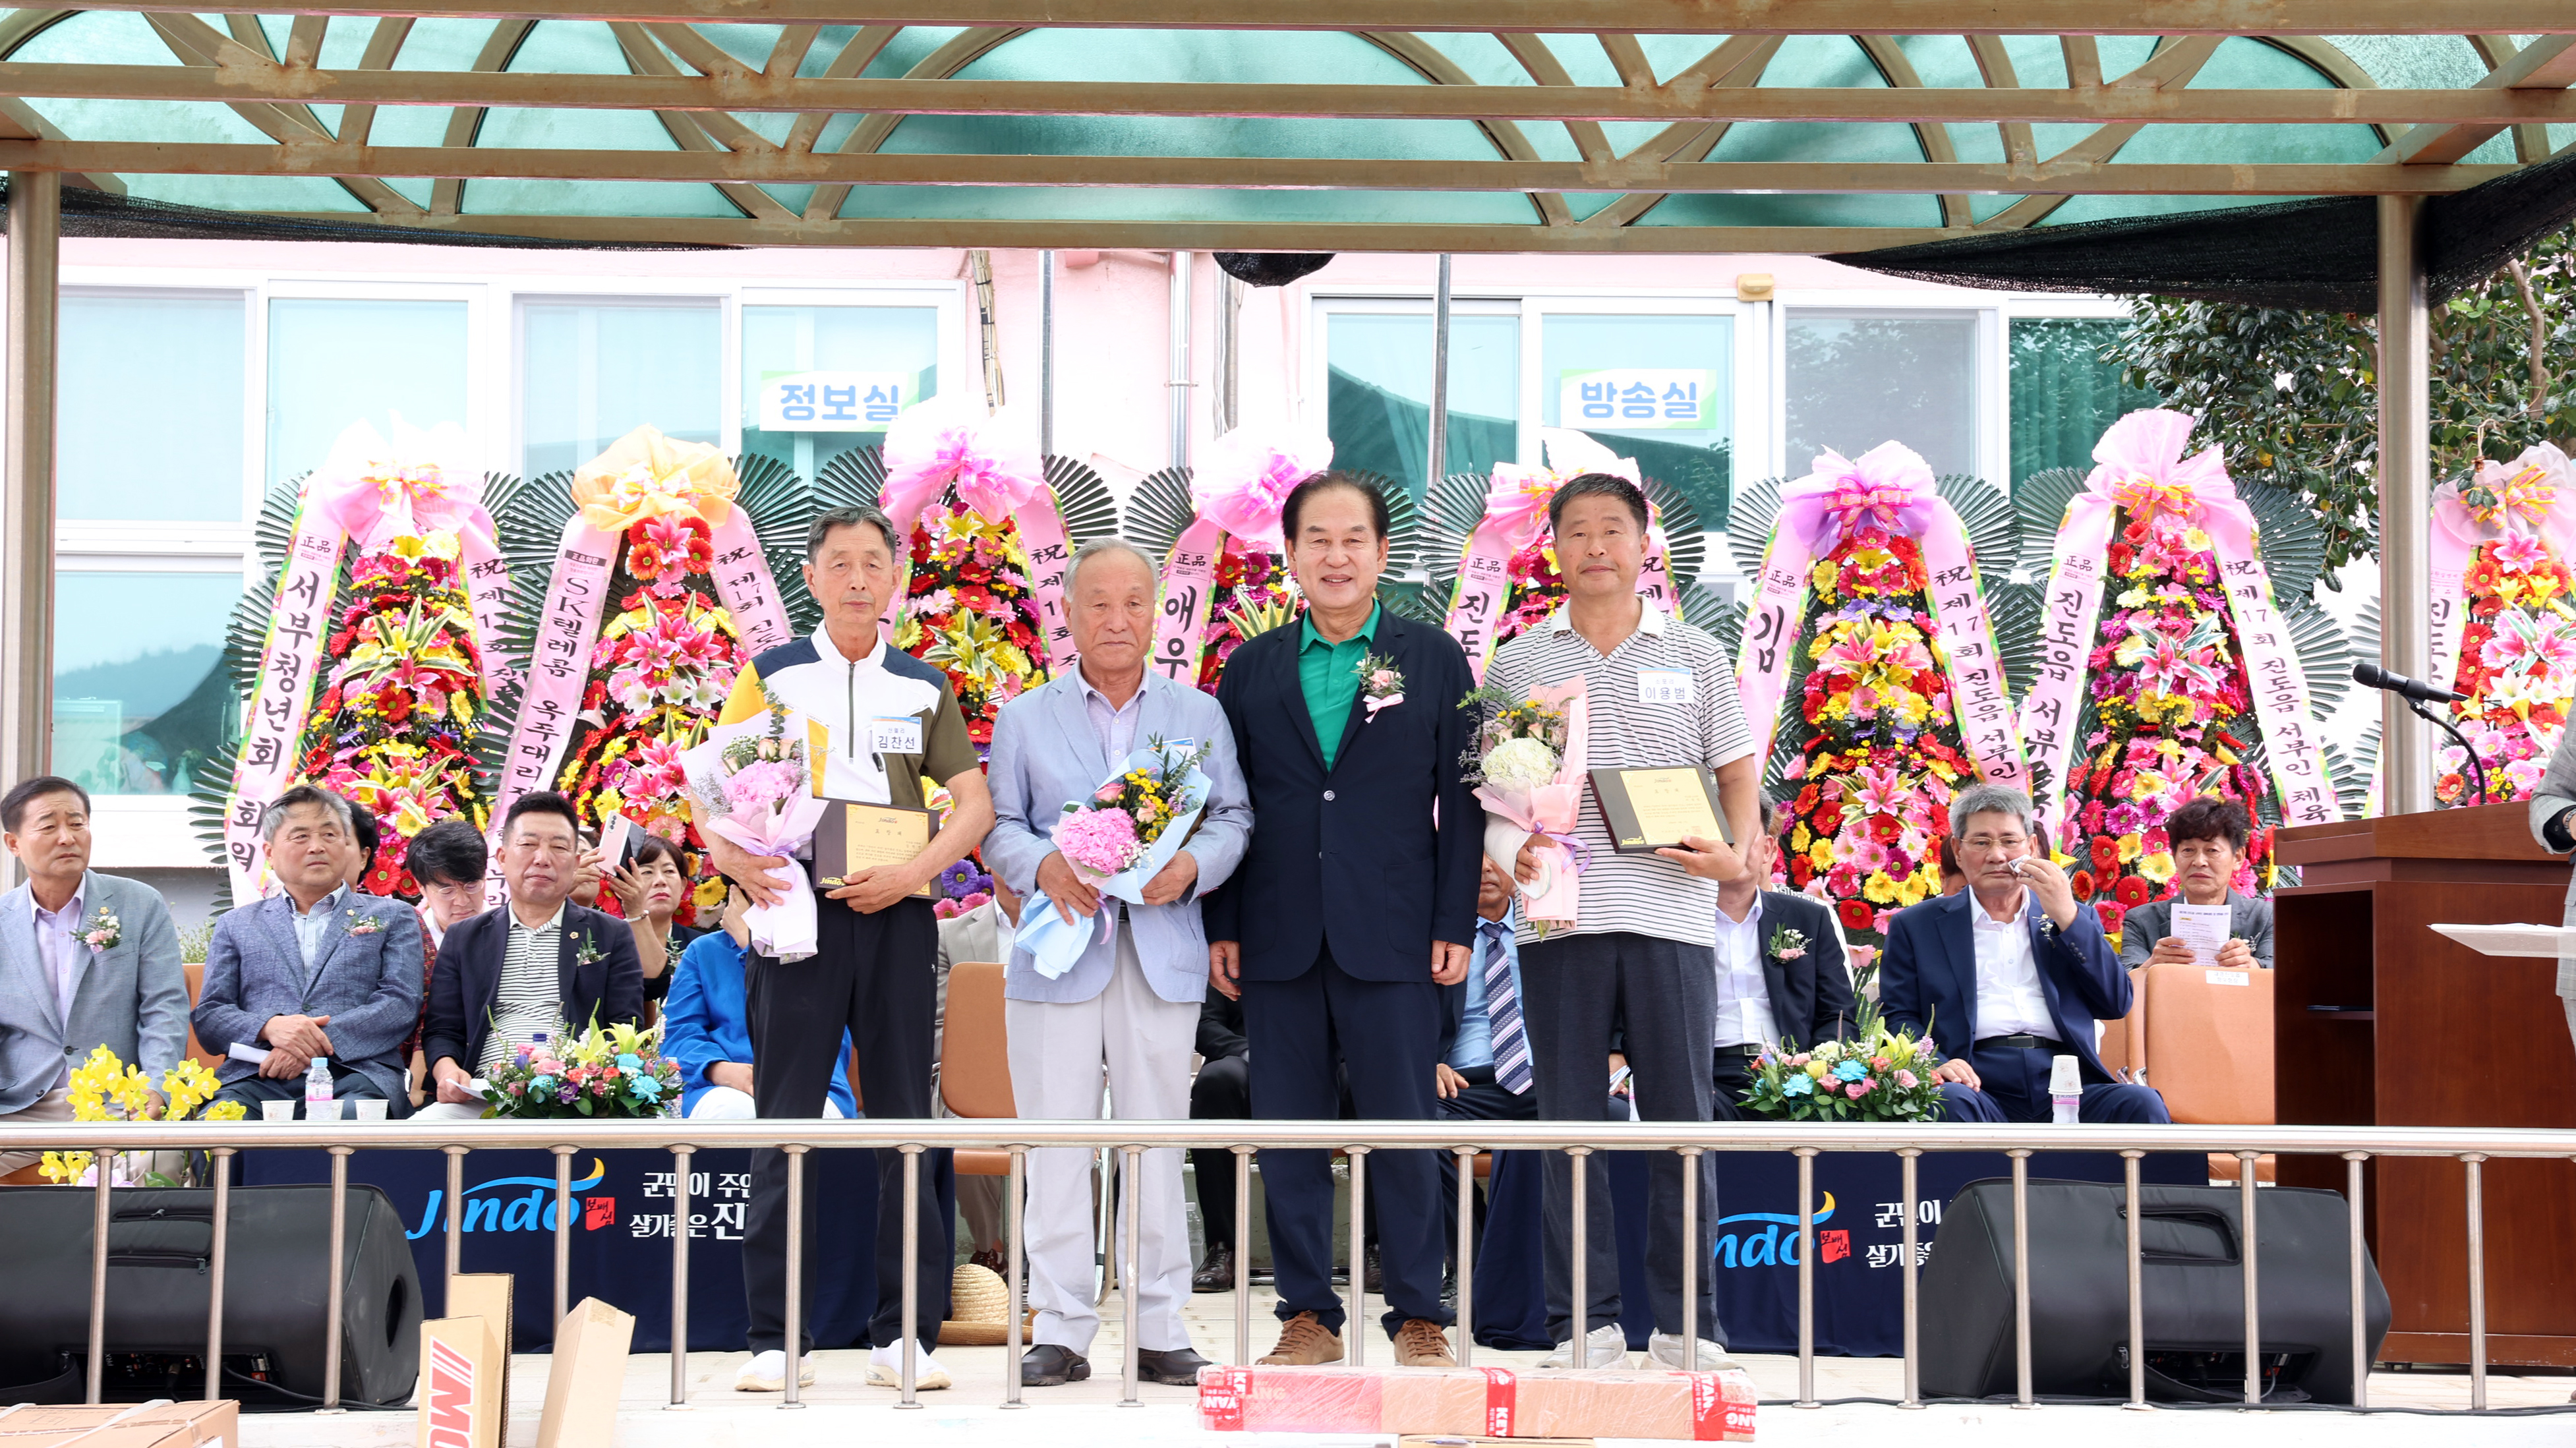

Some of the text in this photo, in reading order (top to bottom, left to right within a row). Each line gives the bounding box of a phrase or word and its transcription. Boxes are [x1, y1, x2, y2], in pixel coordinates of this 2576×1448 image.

[780, 384, 899, 422] 정보실
[1581, 381, 1698, 419] 방송실
[300, 536, 332, 553] 正品
[1030, 544, 1069, 565] 祝
[1175, 553, 1206, 567] 正品
[1470, 558, 1501, 573] 正品
[1769, 569, 1796, 588] 正品
[1934, 565, 1972, 587] 祝
[2064, 555, 2093, 572] 正品
[2225, 560, 2258, 576] 祝
[717, 546, 755, 565] 祝
[745, 619, 785, 652] 진도
[542, 577, 590, 678] SK텔레콤
[2045, 590, 2083, 682] 진도읍
[248, 571, 320, 776] 서부청년회
[2258, 657, 2300, 714] 진도읍
[1645, 687, 1685, 700] 이용범
[1960, 668, 2004, 723] 진도읍
[878, 736, 914, 749] 김찬선
[1976, 728, 2018, 779] 서부인
[2274, 722, 2312, 776] 서부인
[406, 1188, 580, 1240] Jndo
[711, 1203, 749, 1240] 진
